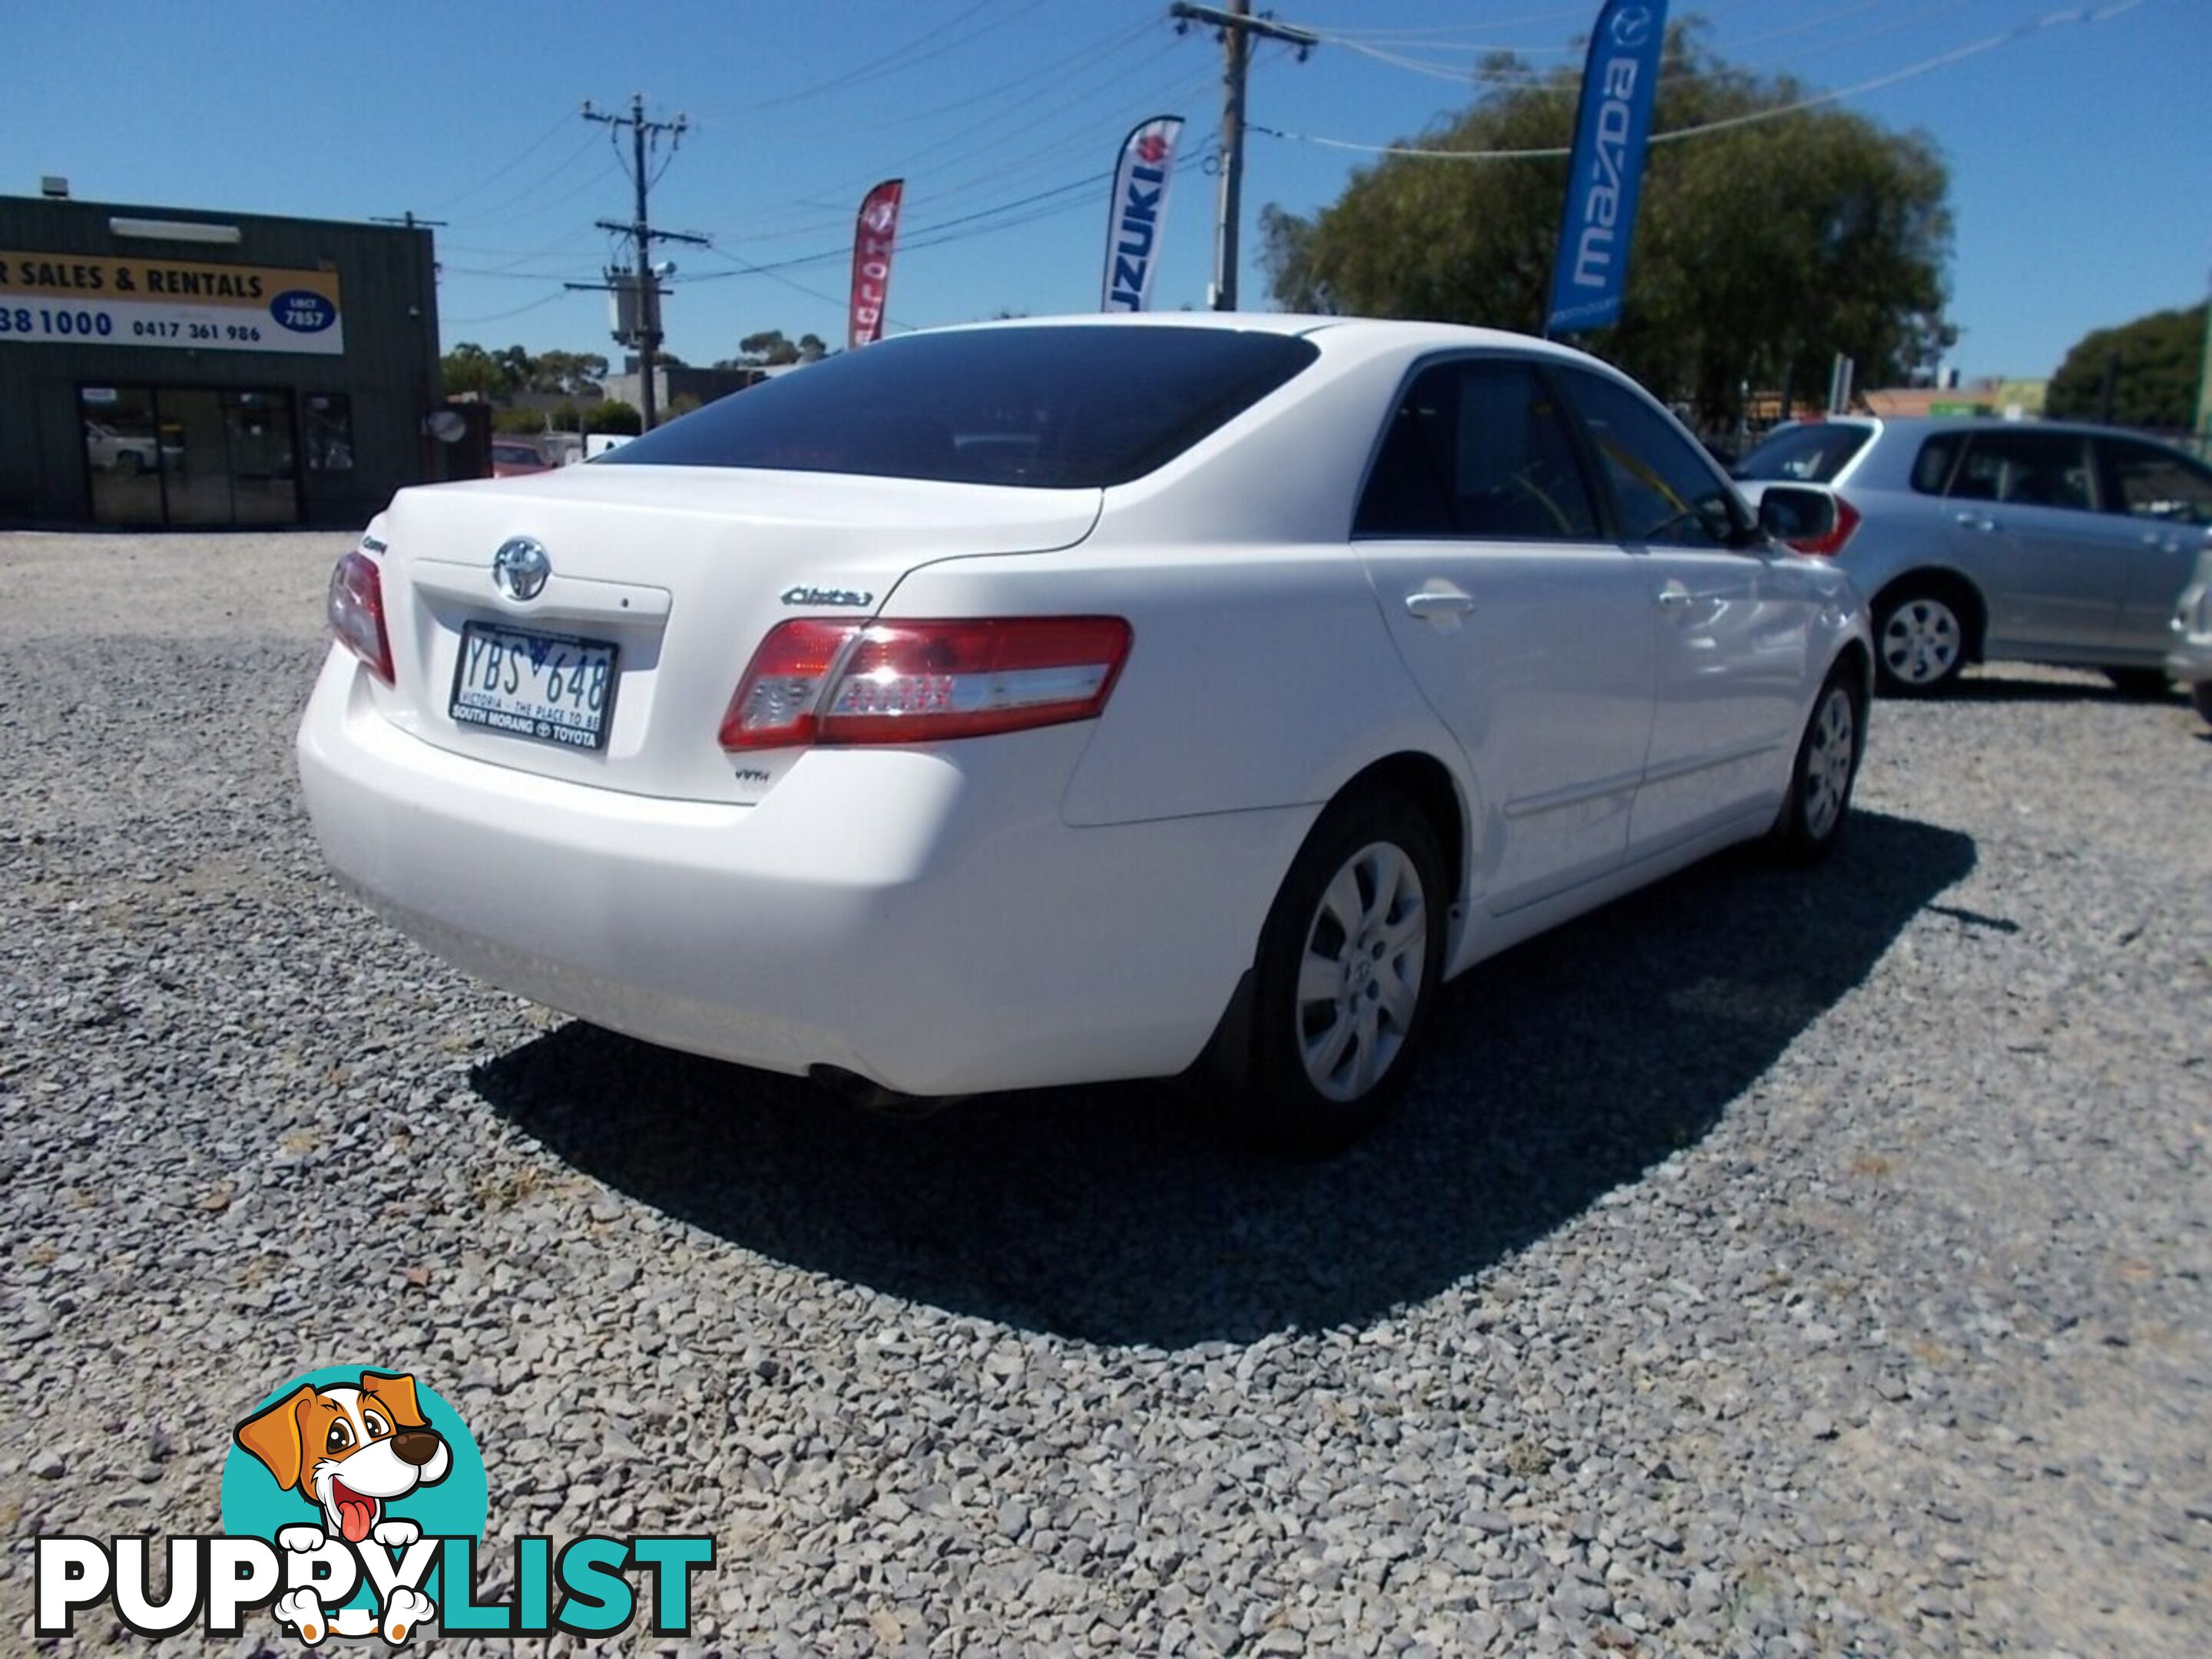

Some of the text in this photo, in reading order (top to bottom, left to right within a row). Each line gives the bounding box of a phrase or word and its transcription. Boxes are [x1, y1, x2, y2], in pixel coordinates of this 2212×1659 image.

[20, 261, 104, 290] SALES
[116, 267, 136, 291] &
[147, 269, 263, 299] RENTALS
[133, 320, 180, 337] 0417
[189, 323, 219, 339] 361
[227, 325, 261, 342] 986
[285, 310, 324, 326] 7857
[468, 637, 608, 712] YBS 648
[452, 704, 597, 748] SOUTH MORANG TOYOTA
[462, 692, 503, 709] VICTORIA
[515, 700, 531, 716] THE
[535, 705, 565, 724] PLACE
[570, 714, 582, 726] TO
[586, 715, 600, 730] BE
